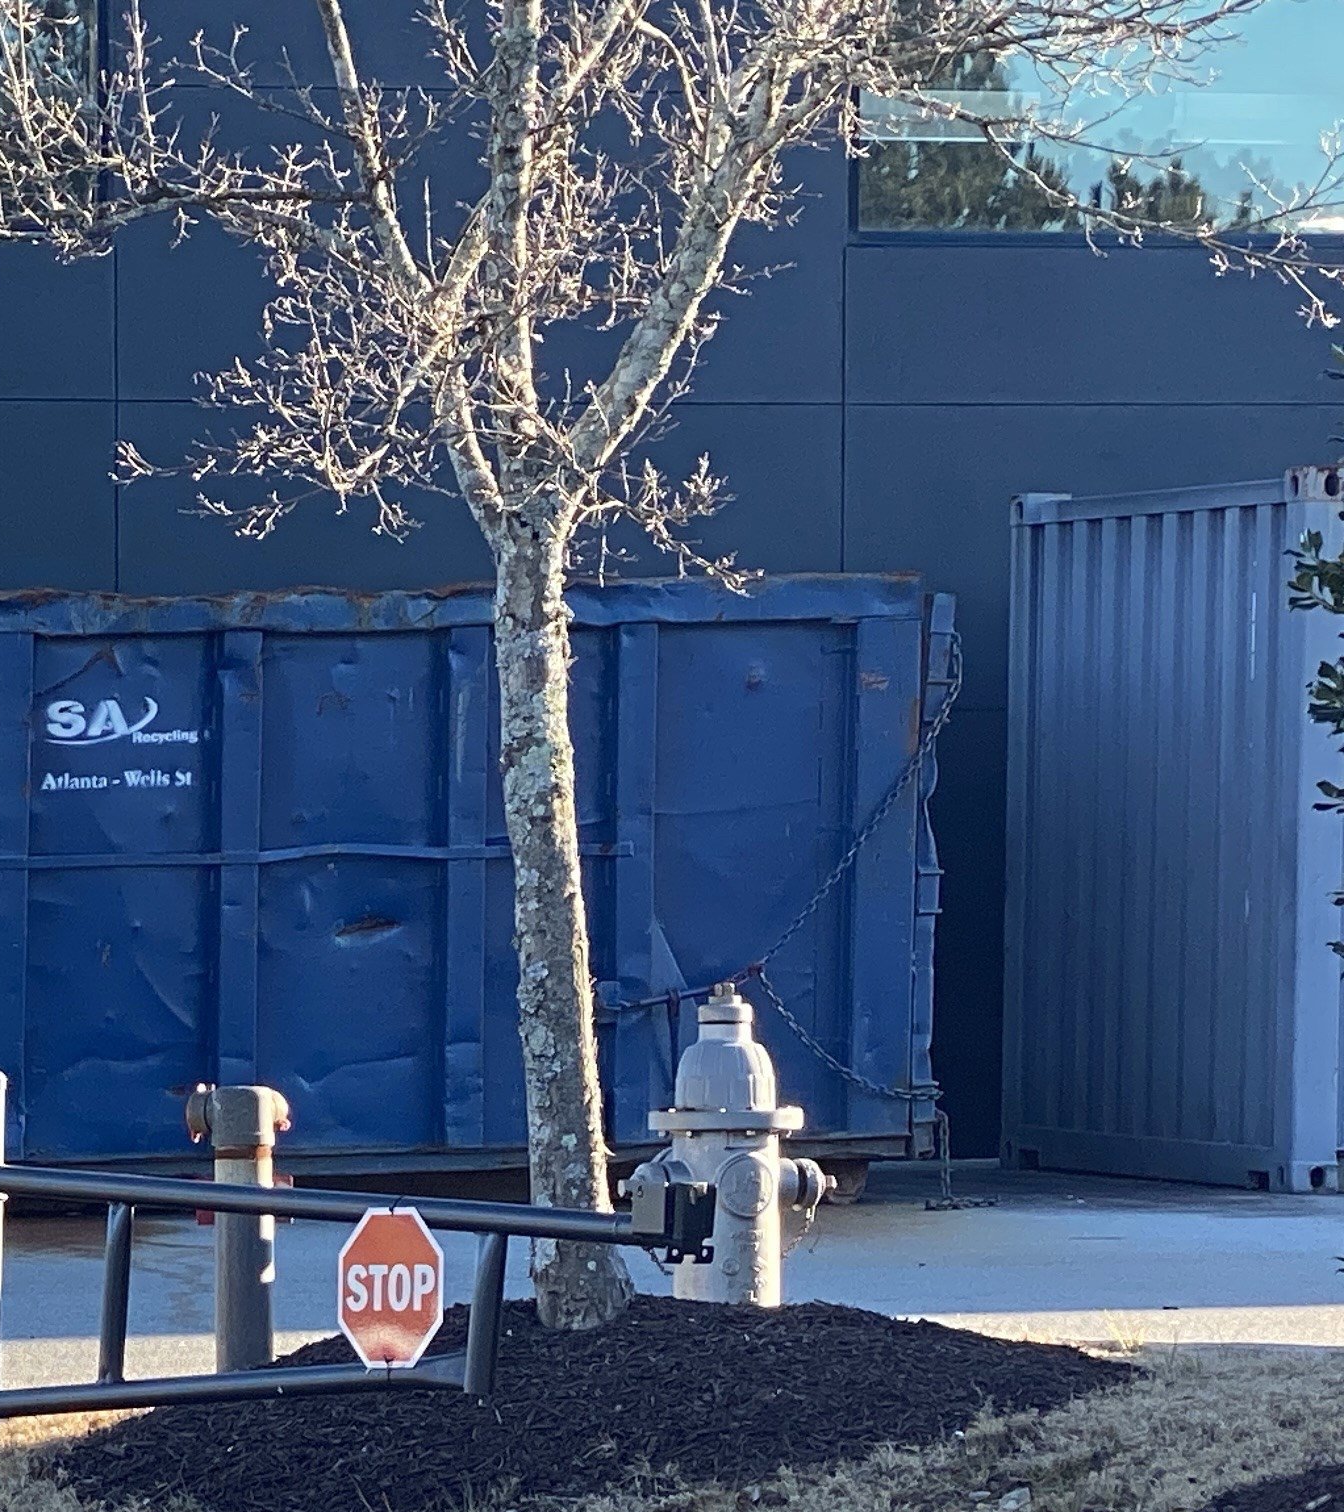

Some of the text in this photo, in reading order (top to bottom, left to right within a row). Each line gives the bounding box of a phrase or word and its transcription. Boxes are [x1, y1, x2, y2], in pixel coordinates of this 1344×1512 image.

[46, 699, 129, 738] SA
[132, 729, 199, 744] Recycling
[41, 772, 108, 790] Atlanta
[124, 769, 170, 787] Wells
[346, 1264, 435, 1312] STOP
